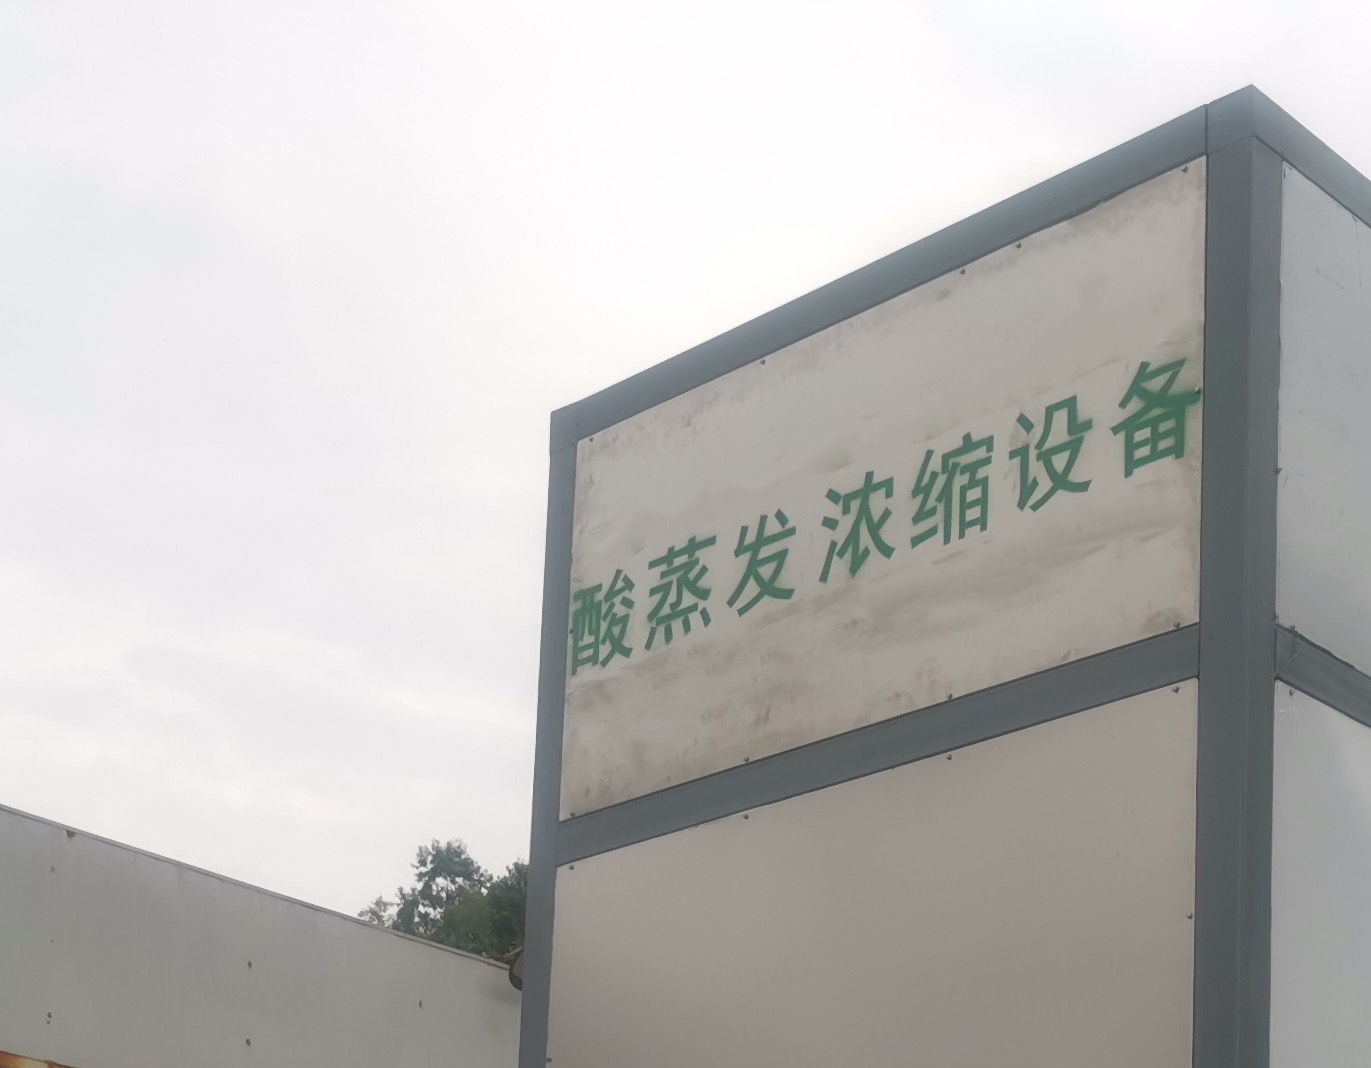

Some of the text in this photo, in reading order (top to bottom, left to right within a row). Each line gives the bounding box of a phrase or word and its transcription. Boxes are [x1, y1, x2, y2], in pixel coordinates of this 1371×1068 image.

[571, 357, 1203, 675] 酸蒸发浓缩设备
